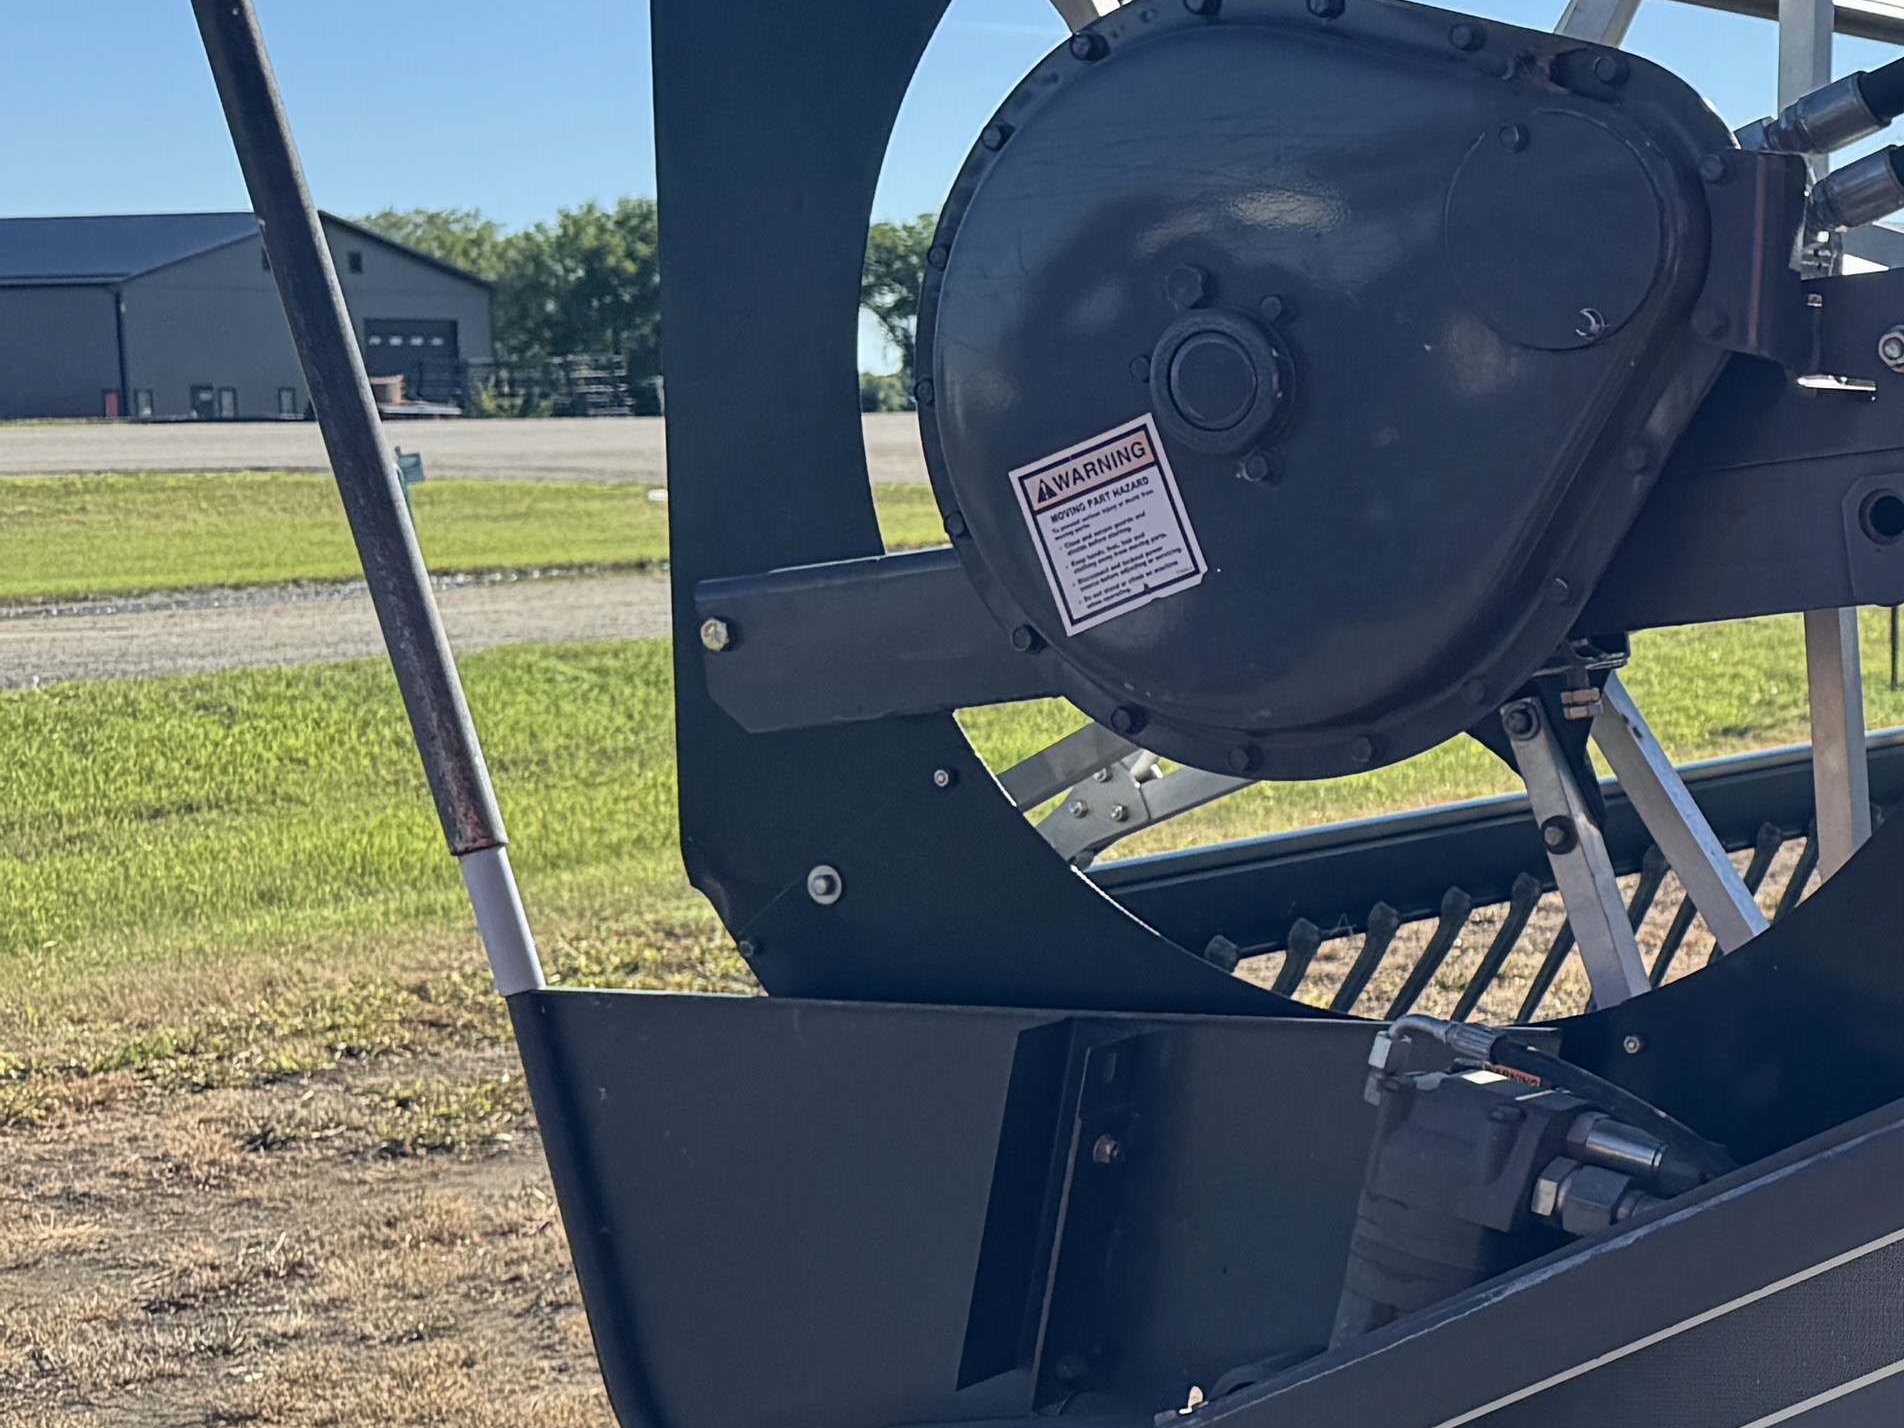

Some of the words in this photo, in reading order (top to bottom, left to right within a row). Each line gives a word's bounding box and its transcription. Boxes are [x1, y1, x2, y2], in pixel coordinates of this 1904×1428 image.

[1052, 441, 1146, 491] WARNING
[1050, 503, 1087, 523] MOVING
[1087, 493, 1110, 509] PART
[1112, 476, 1149, 497] HAZARD
